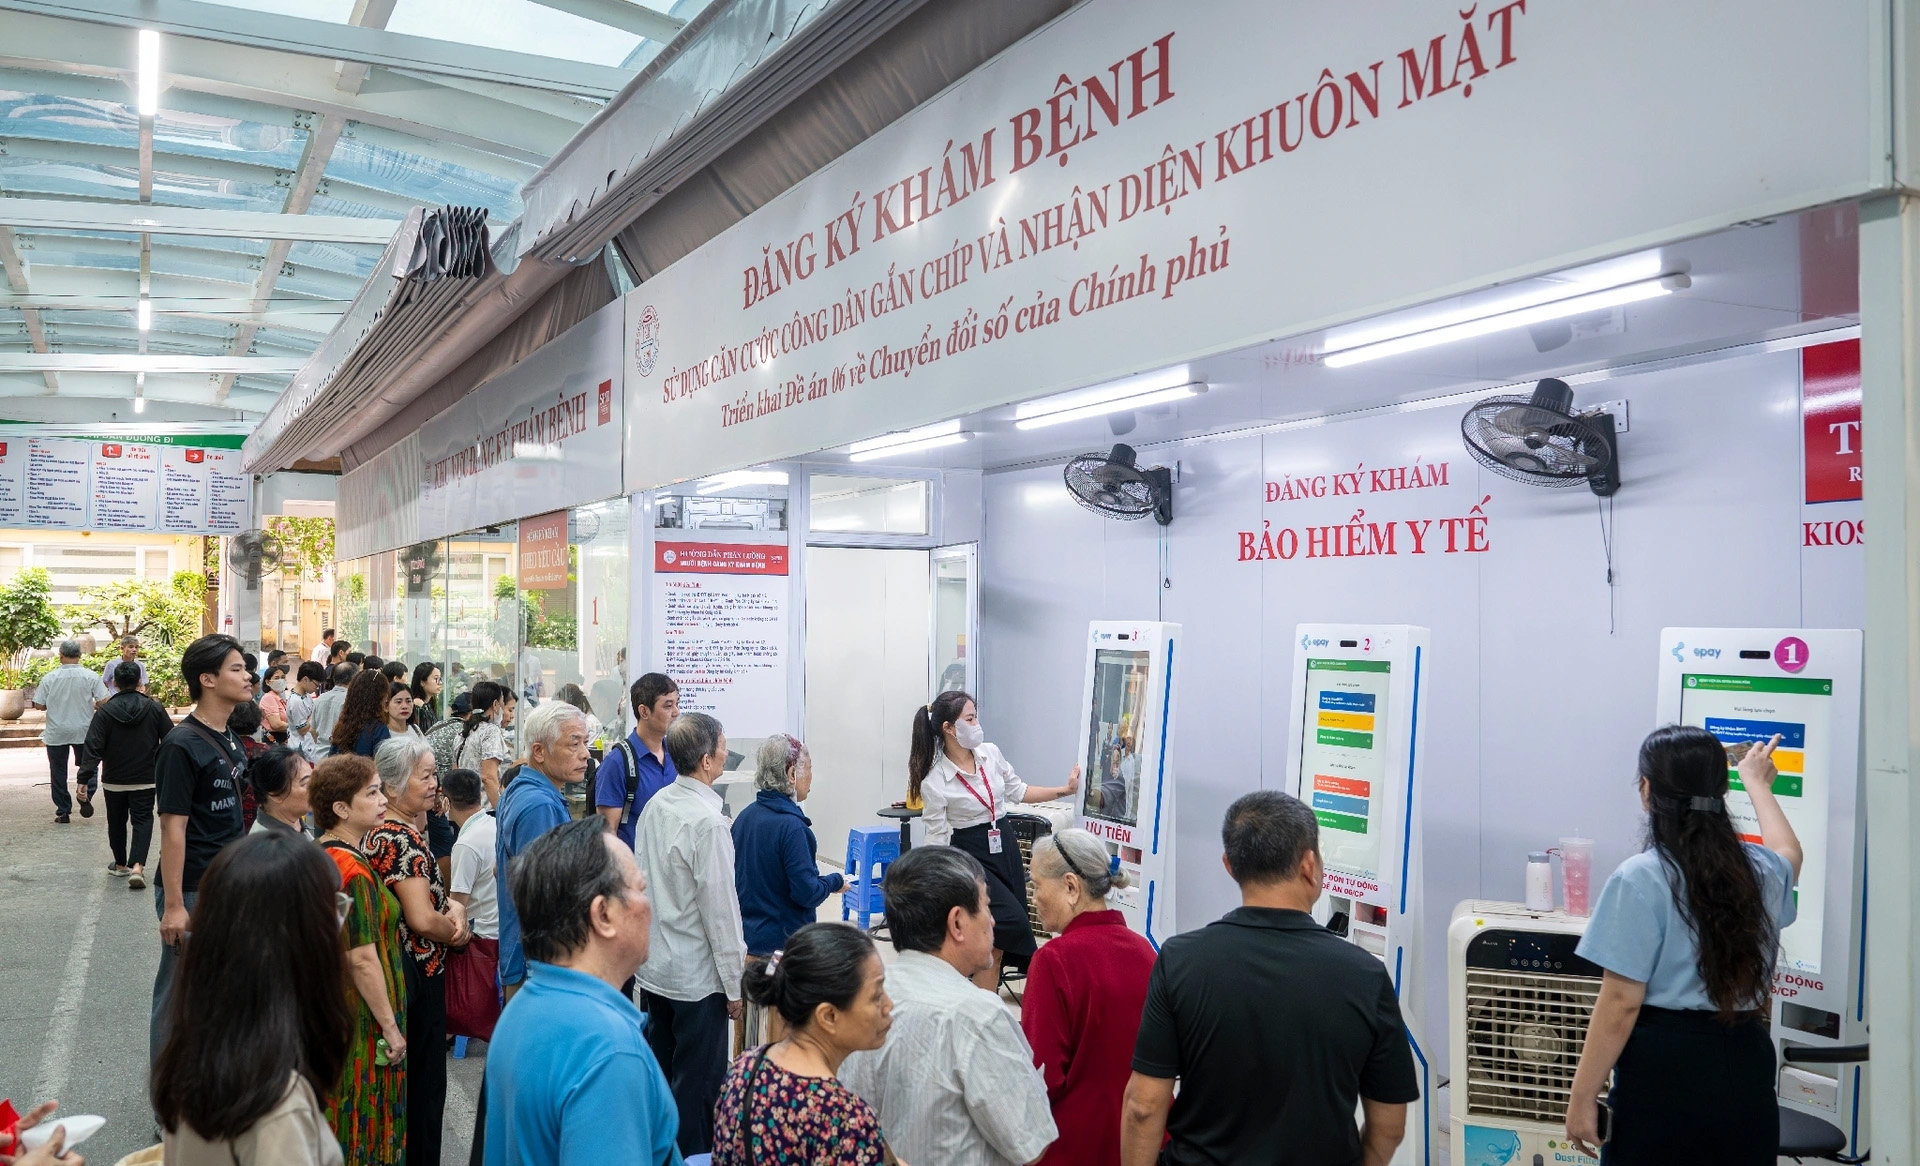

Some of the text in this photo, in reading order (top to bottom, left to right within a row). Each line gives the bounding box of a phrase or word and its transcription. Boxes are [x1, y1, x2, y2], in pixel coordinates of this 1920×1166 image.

[743, 31, 1176, 310] ĐĂNG KÝ KHÁM BỆNH
[663, 367, 681, 404] SỬ
[680, 359, 710, 399] DỤNG
[711, 345, 738, 383] CĂN
[740, 326, 779, 374] CƯỚC
[781, 309, 828, 355] CÔNG
[831, 288, 866, 337] DÂN
[870, 262, 915, 318] GẮN
[920, 238, 973, 300] CHÍP
[977, 216, 1013, 274] VÀ
[1018, 185, 1109, 260] NHẬN
[1118, 141, 1206, 222] DIỆN
[1214, 61, 1384, 182] KHUÔN
[1397, 0, 1527, 109] MẶT
[722, 224, 1231, 428] Triển khai Đề án 06 về Chuyển đổi số của Chính phủ
[496, 419, 510, 465] KÝ
[511, 406, 546, 459] KHÁM
[548, 392, 588, 450] BỆNH
[1829, 421, 1862, 455] T
[1265, 455, 1449, 503] ĐĂNG KÝ KHÁM
[1237, 495, 1492, 562] BẢO HIỂM Y TẾ
[593, 596, 598, 625] 1
[1364, 638, 1370, 651] 2
[1693, 647, 1721, 659] epay
[1784, 643, 1800, 664] 1
[1105, 825, 1132, 843] TIÊN
[1328, 873, 1345, 884] ĐÓN
[1345, 878, 1356, 888] TỰ
[1356, 880, 1379, 892] ĐỘNG
[1770, 985, 1798, 997] 6/CP
[1773, 972, 1824, 991] Ự ĐỘNG
[1555, 1152, 1576, 1163] Dust
